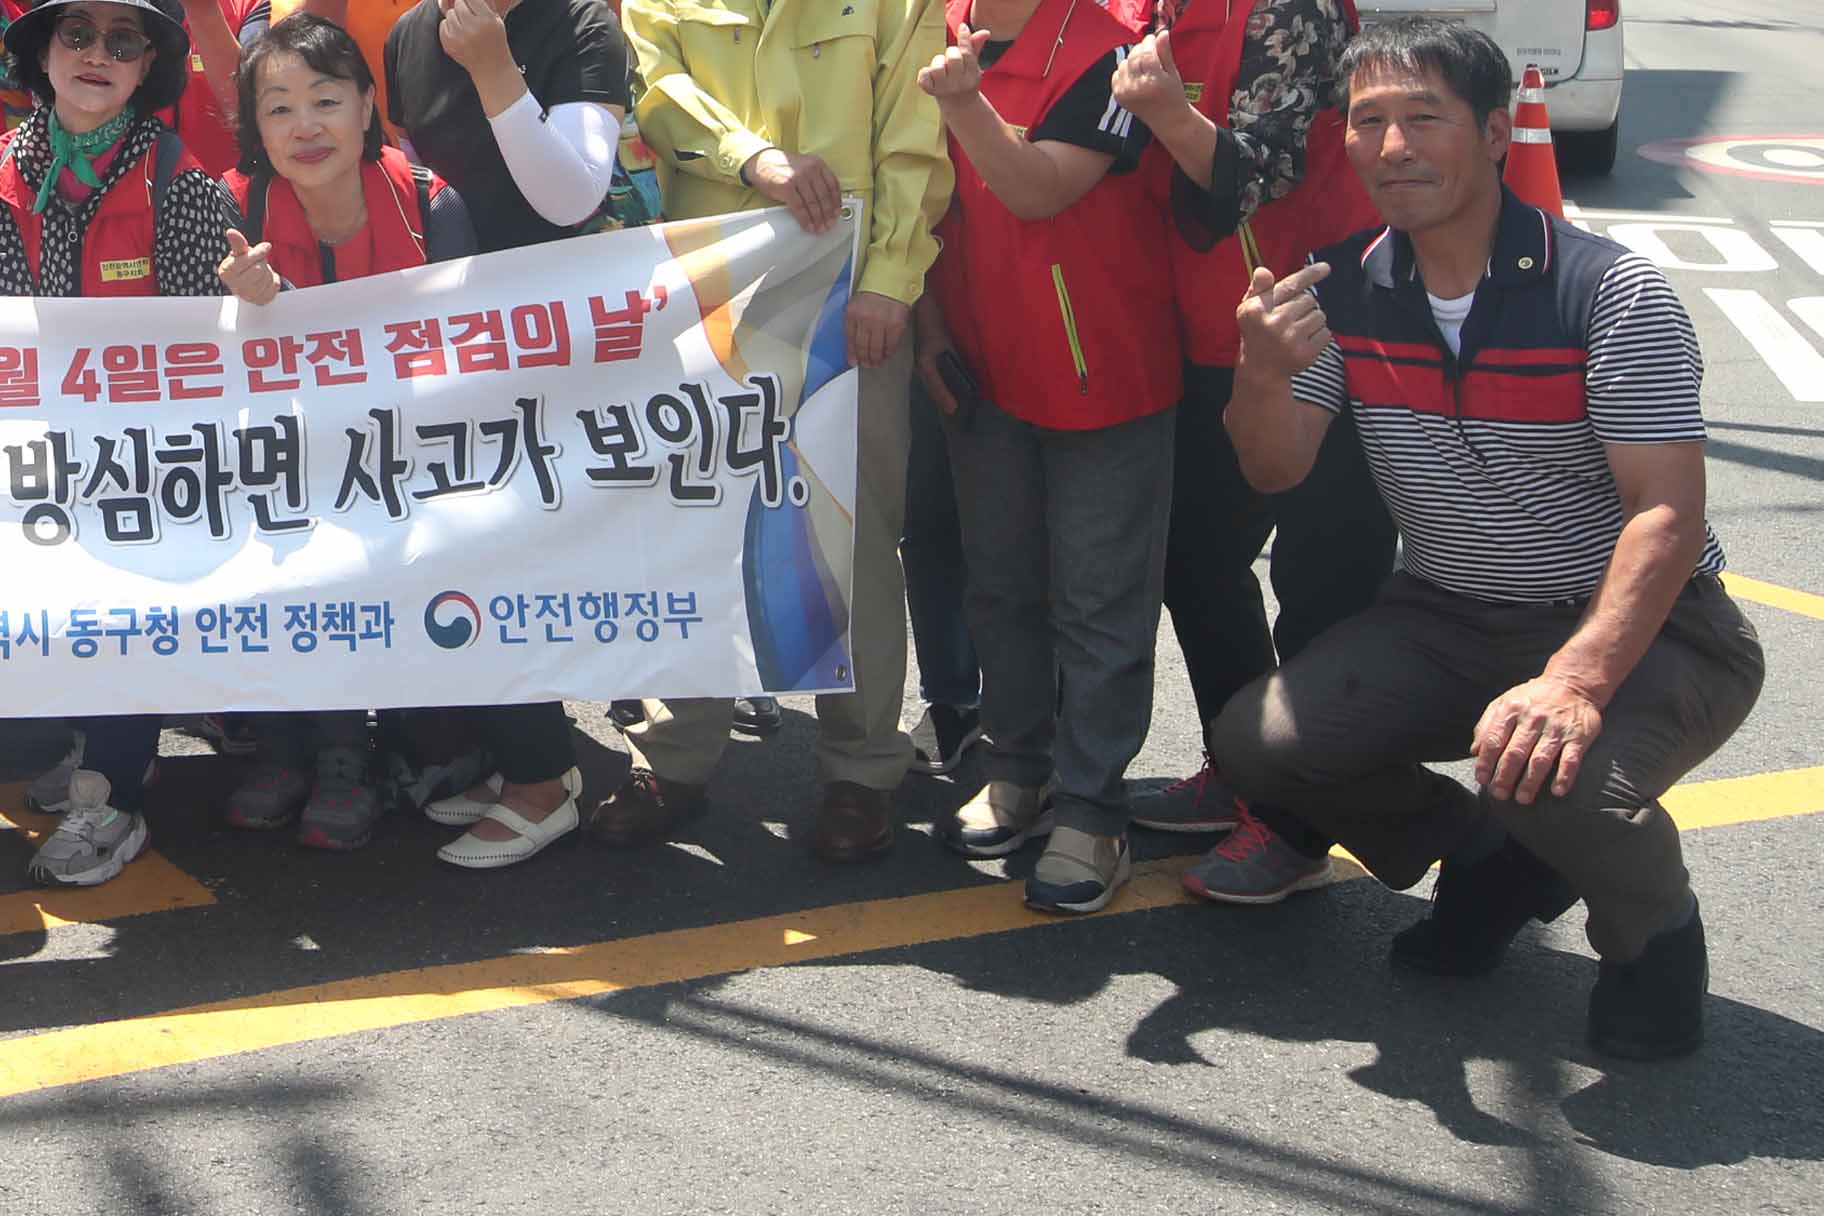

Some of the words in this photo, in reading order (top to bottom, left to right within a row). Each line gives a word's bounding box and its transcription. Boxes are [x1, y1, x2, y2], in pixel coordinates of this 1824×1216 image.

[60, 341, 225, 403] 4일은
[241, 326, 368, 394] 안전
[383, 299, 572, 380] 점검의
[6, 416, 315, 546] 방심하면
[333, 395, 559, 521] 사고가
[575, 372, 808, 508] 보인다.
[64, 607, 180, 660] 동구청
[195, 601, 270, 655] 안전
[283, 601, 395, 654] 정책과
[489, 590, 704, 645] 안전행정부
